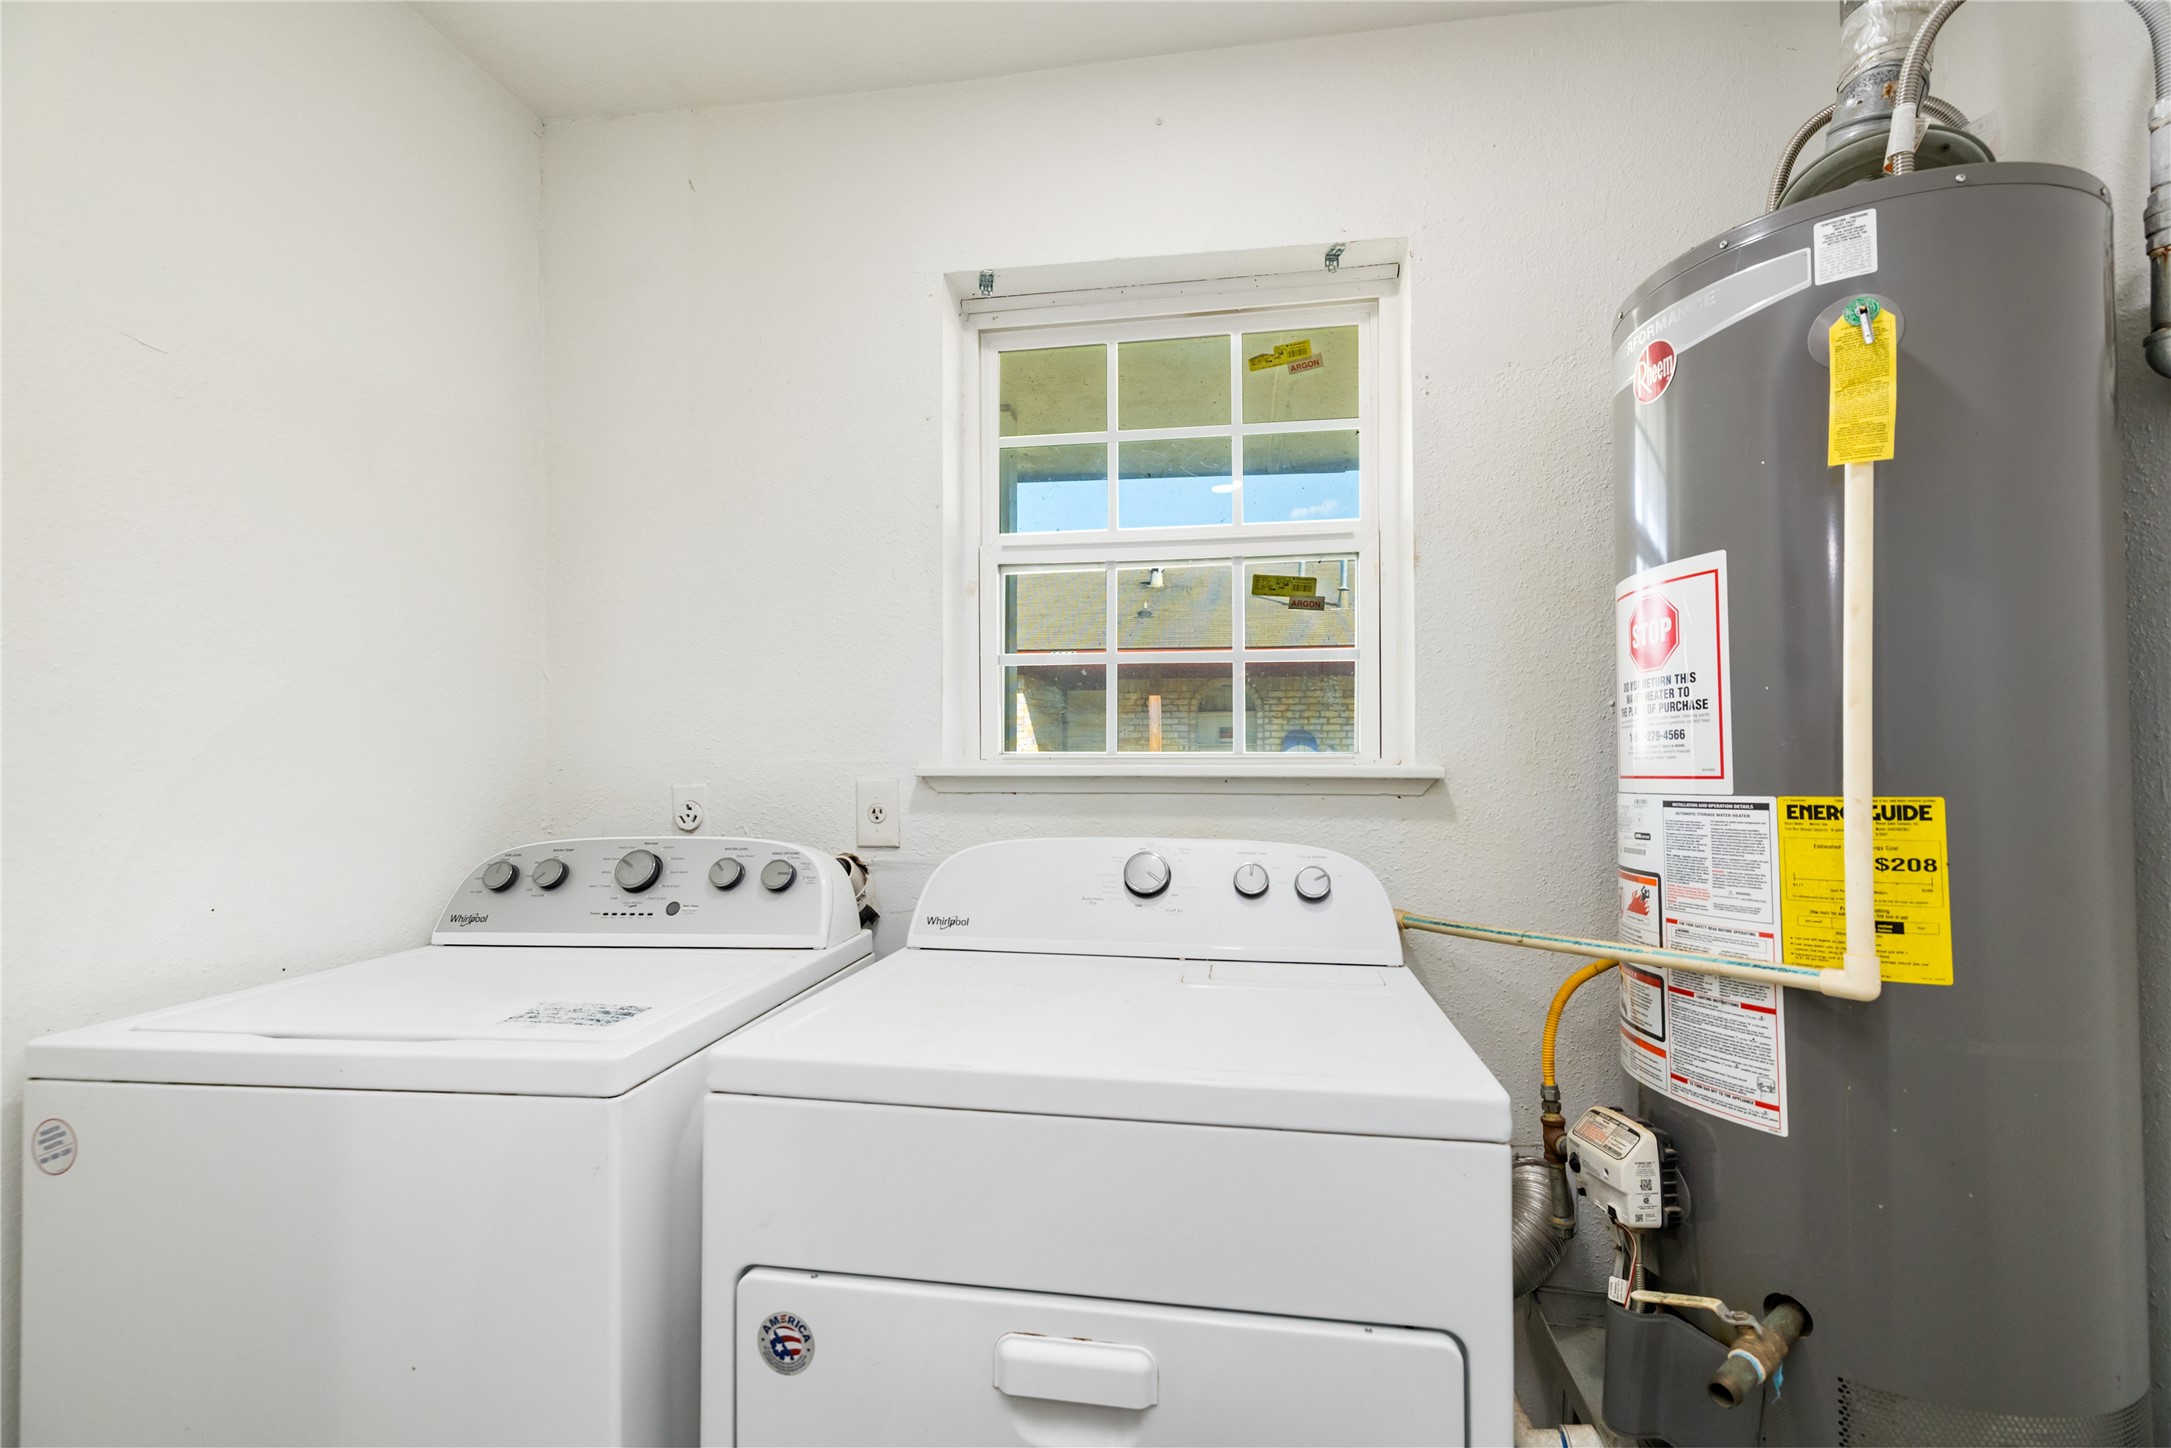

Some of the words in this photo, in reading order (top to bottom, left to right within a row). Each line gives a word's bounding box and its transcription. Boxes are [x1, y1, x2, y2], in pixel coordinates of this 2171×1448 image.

[1290, 358, 1320, 372] ARGON
[1638, 347, 1673, 397] Rheem
[1291, 600, 1320, 608] ARGON
[1632, 616, 1672, 648] STOP
[1642, 675, 1672, 689] RETURN
[1674, 672, 1696, 684] THIS
[1645, 688, 1674, 702] HEATER
[1678, 686, 1690, 698] TO
[1647, 704, 1656, 714] OF
[1659, 698, 1708, 713] PURCHASE
[1874, 857, 1938, 872] $208
[450, 912, 488, 927] Whirlpool
[926, 915, 970, 930] Whirlpool
[763, 1314, 811, 1344] AMERICA
